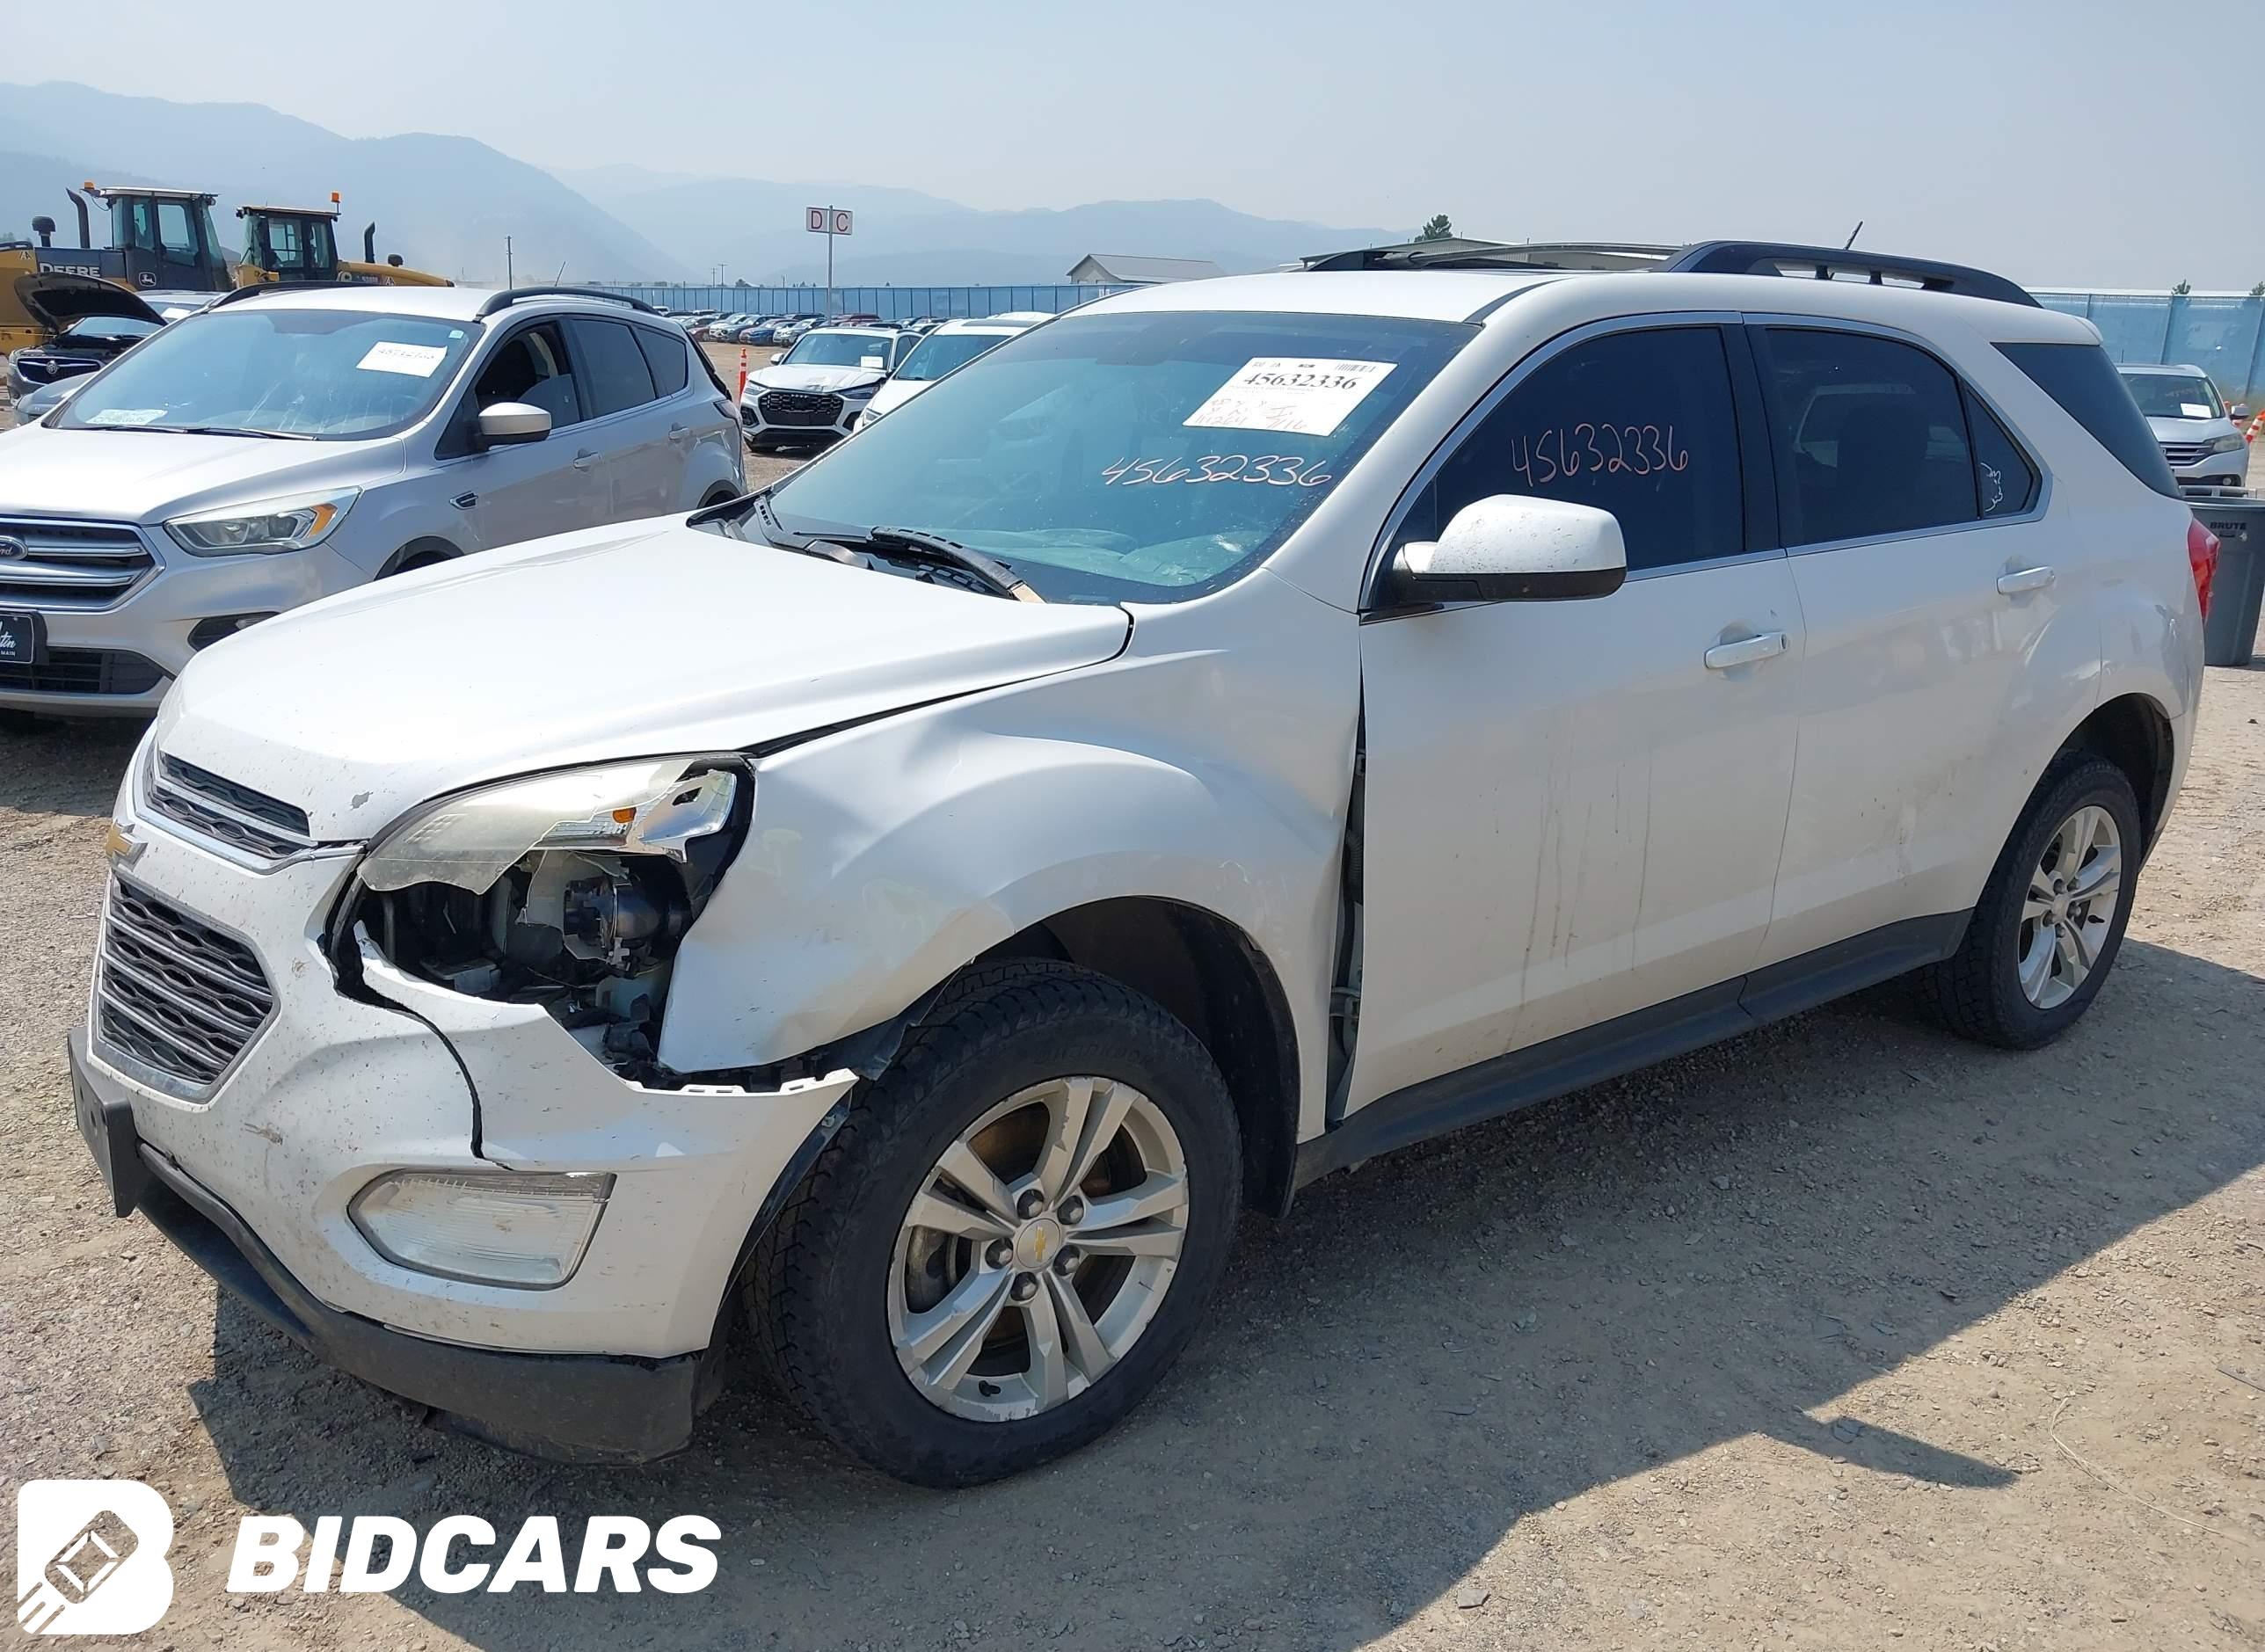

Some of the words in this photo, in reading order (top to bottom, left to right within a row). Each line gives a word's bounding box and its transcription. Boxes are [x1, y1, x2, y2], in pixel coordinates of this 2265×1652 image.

[811, 210, 823, 229] D
[836, 213, 848, 232] C
[39, 263, 101, 277] DEERE
[1242, 372, 1363, 390] 45632336
[1511, 423, 1688, 487] 45632336
[1101, 455, 1332, 488] 45632336
[2209, 521, 2247, 530] BRUTE
